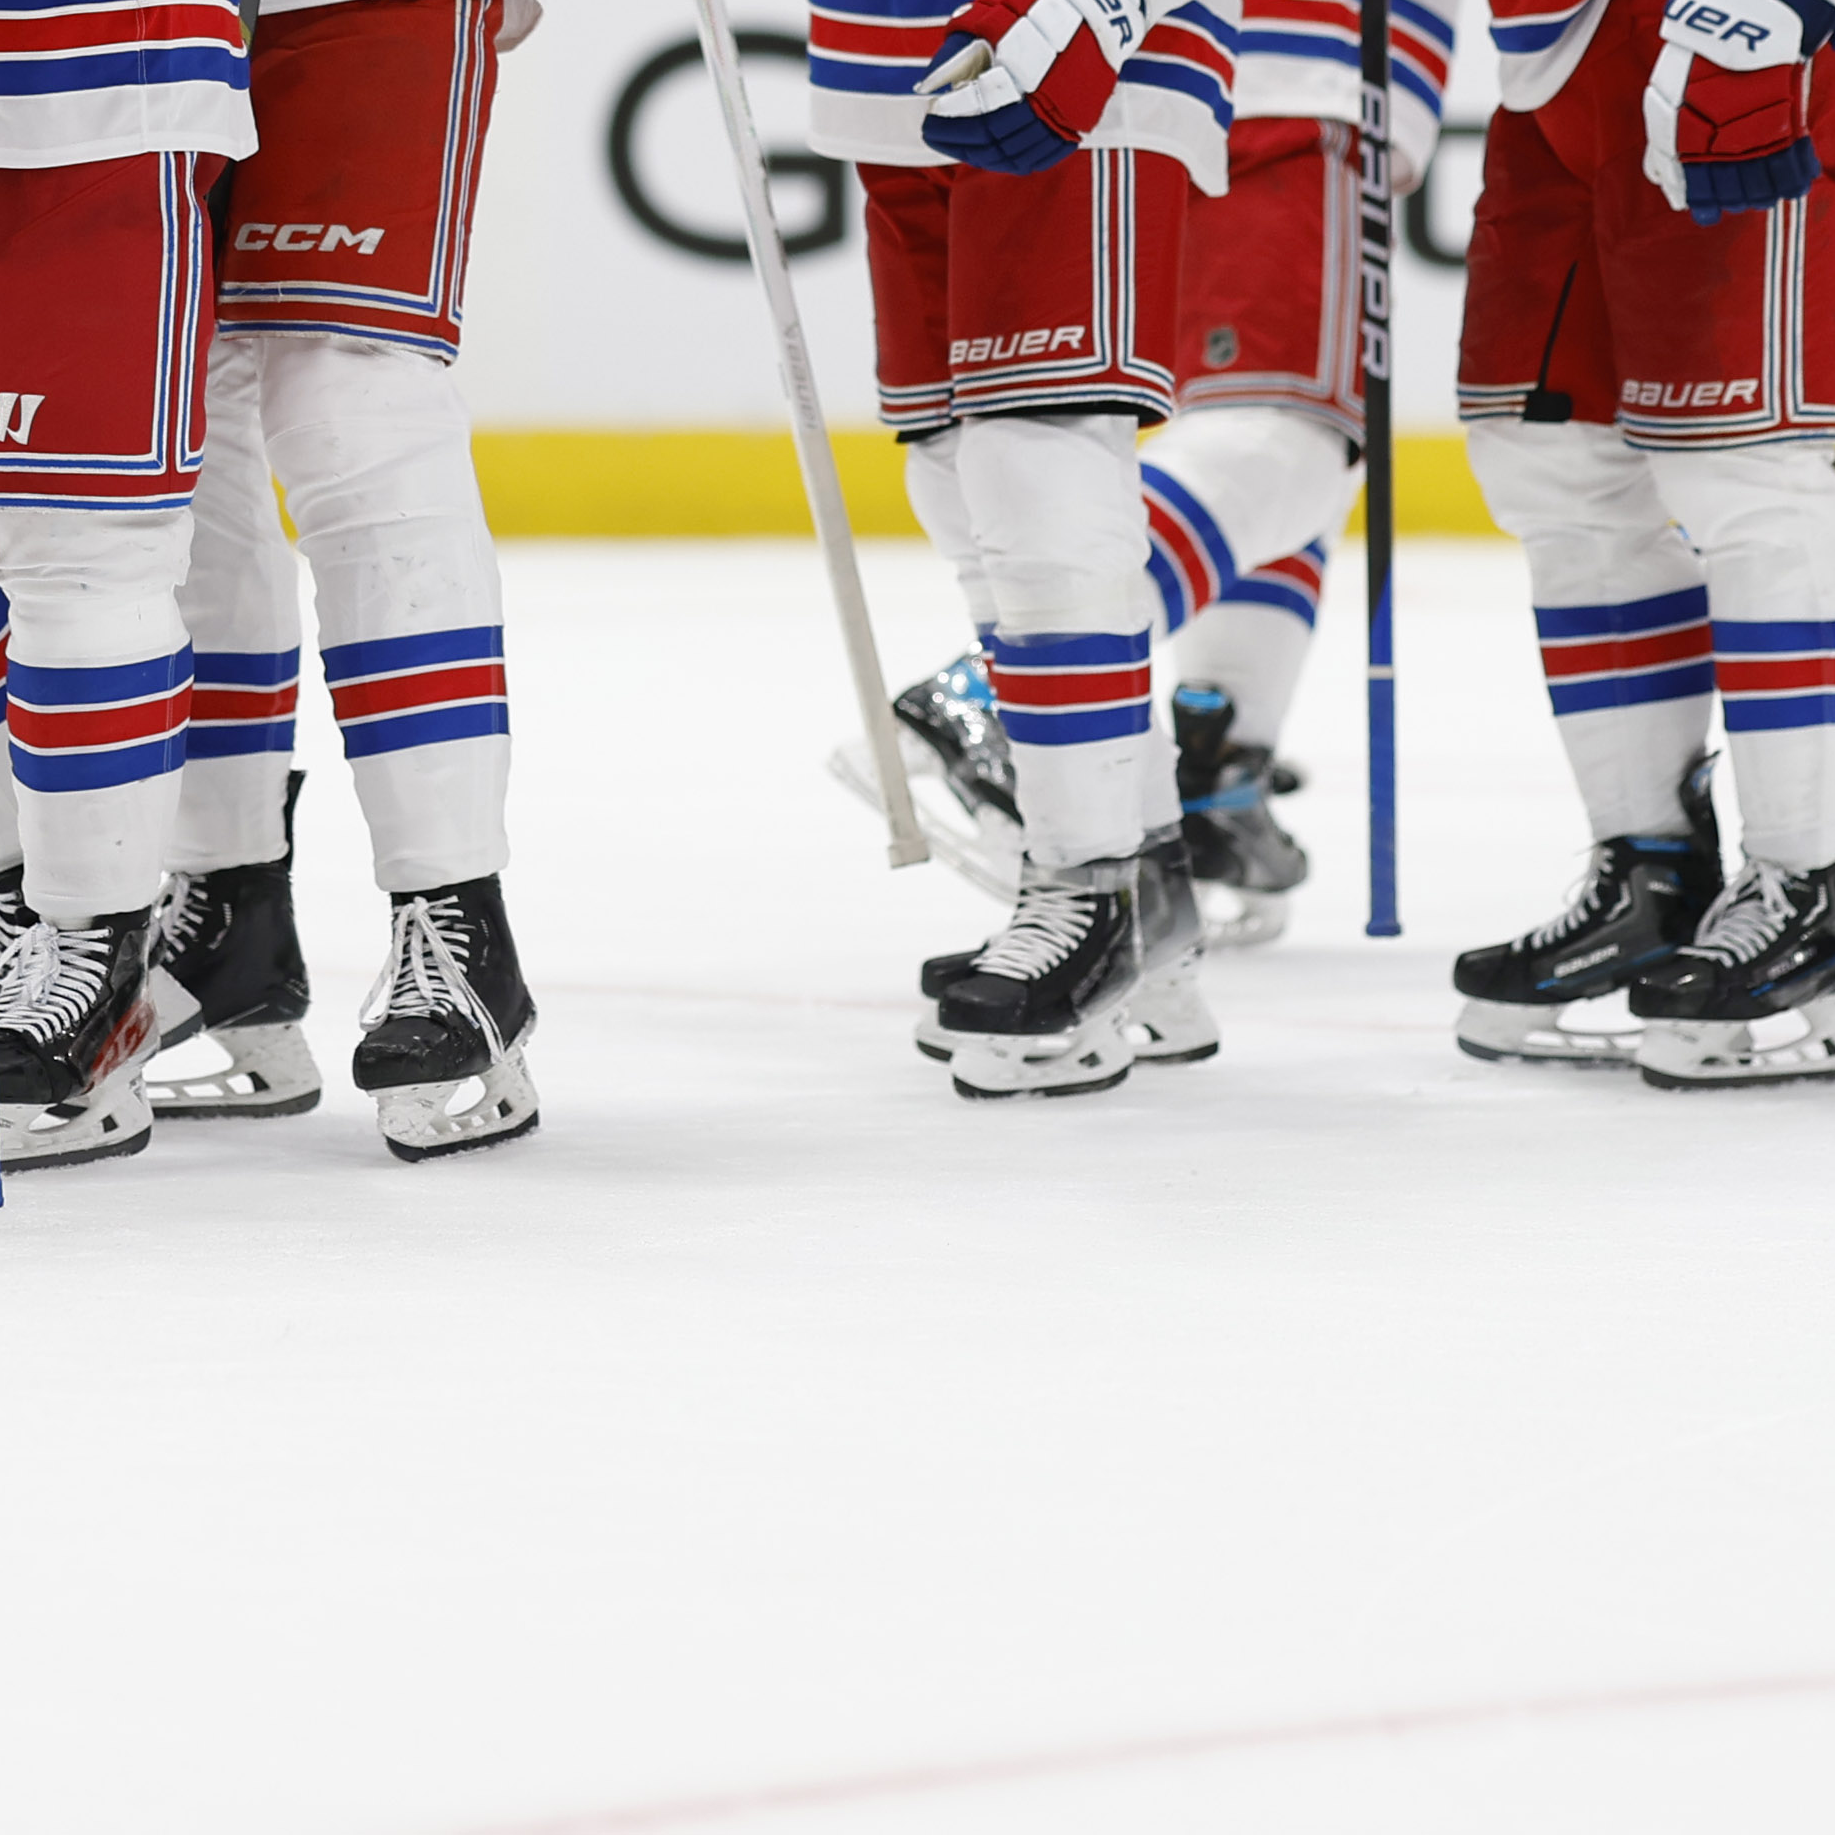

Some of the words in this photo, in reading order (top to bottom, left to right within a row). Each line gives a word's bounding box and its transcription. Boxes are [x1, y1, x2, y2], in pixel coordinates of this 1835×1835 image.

[234, 222, 386, 255] CCM
[949, 324, 1086, 364] BAUER
[1621, 378, 1760, 408] BAUER
